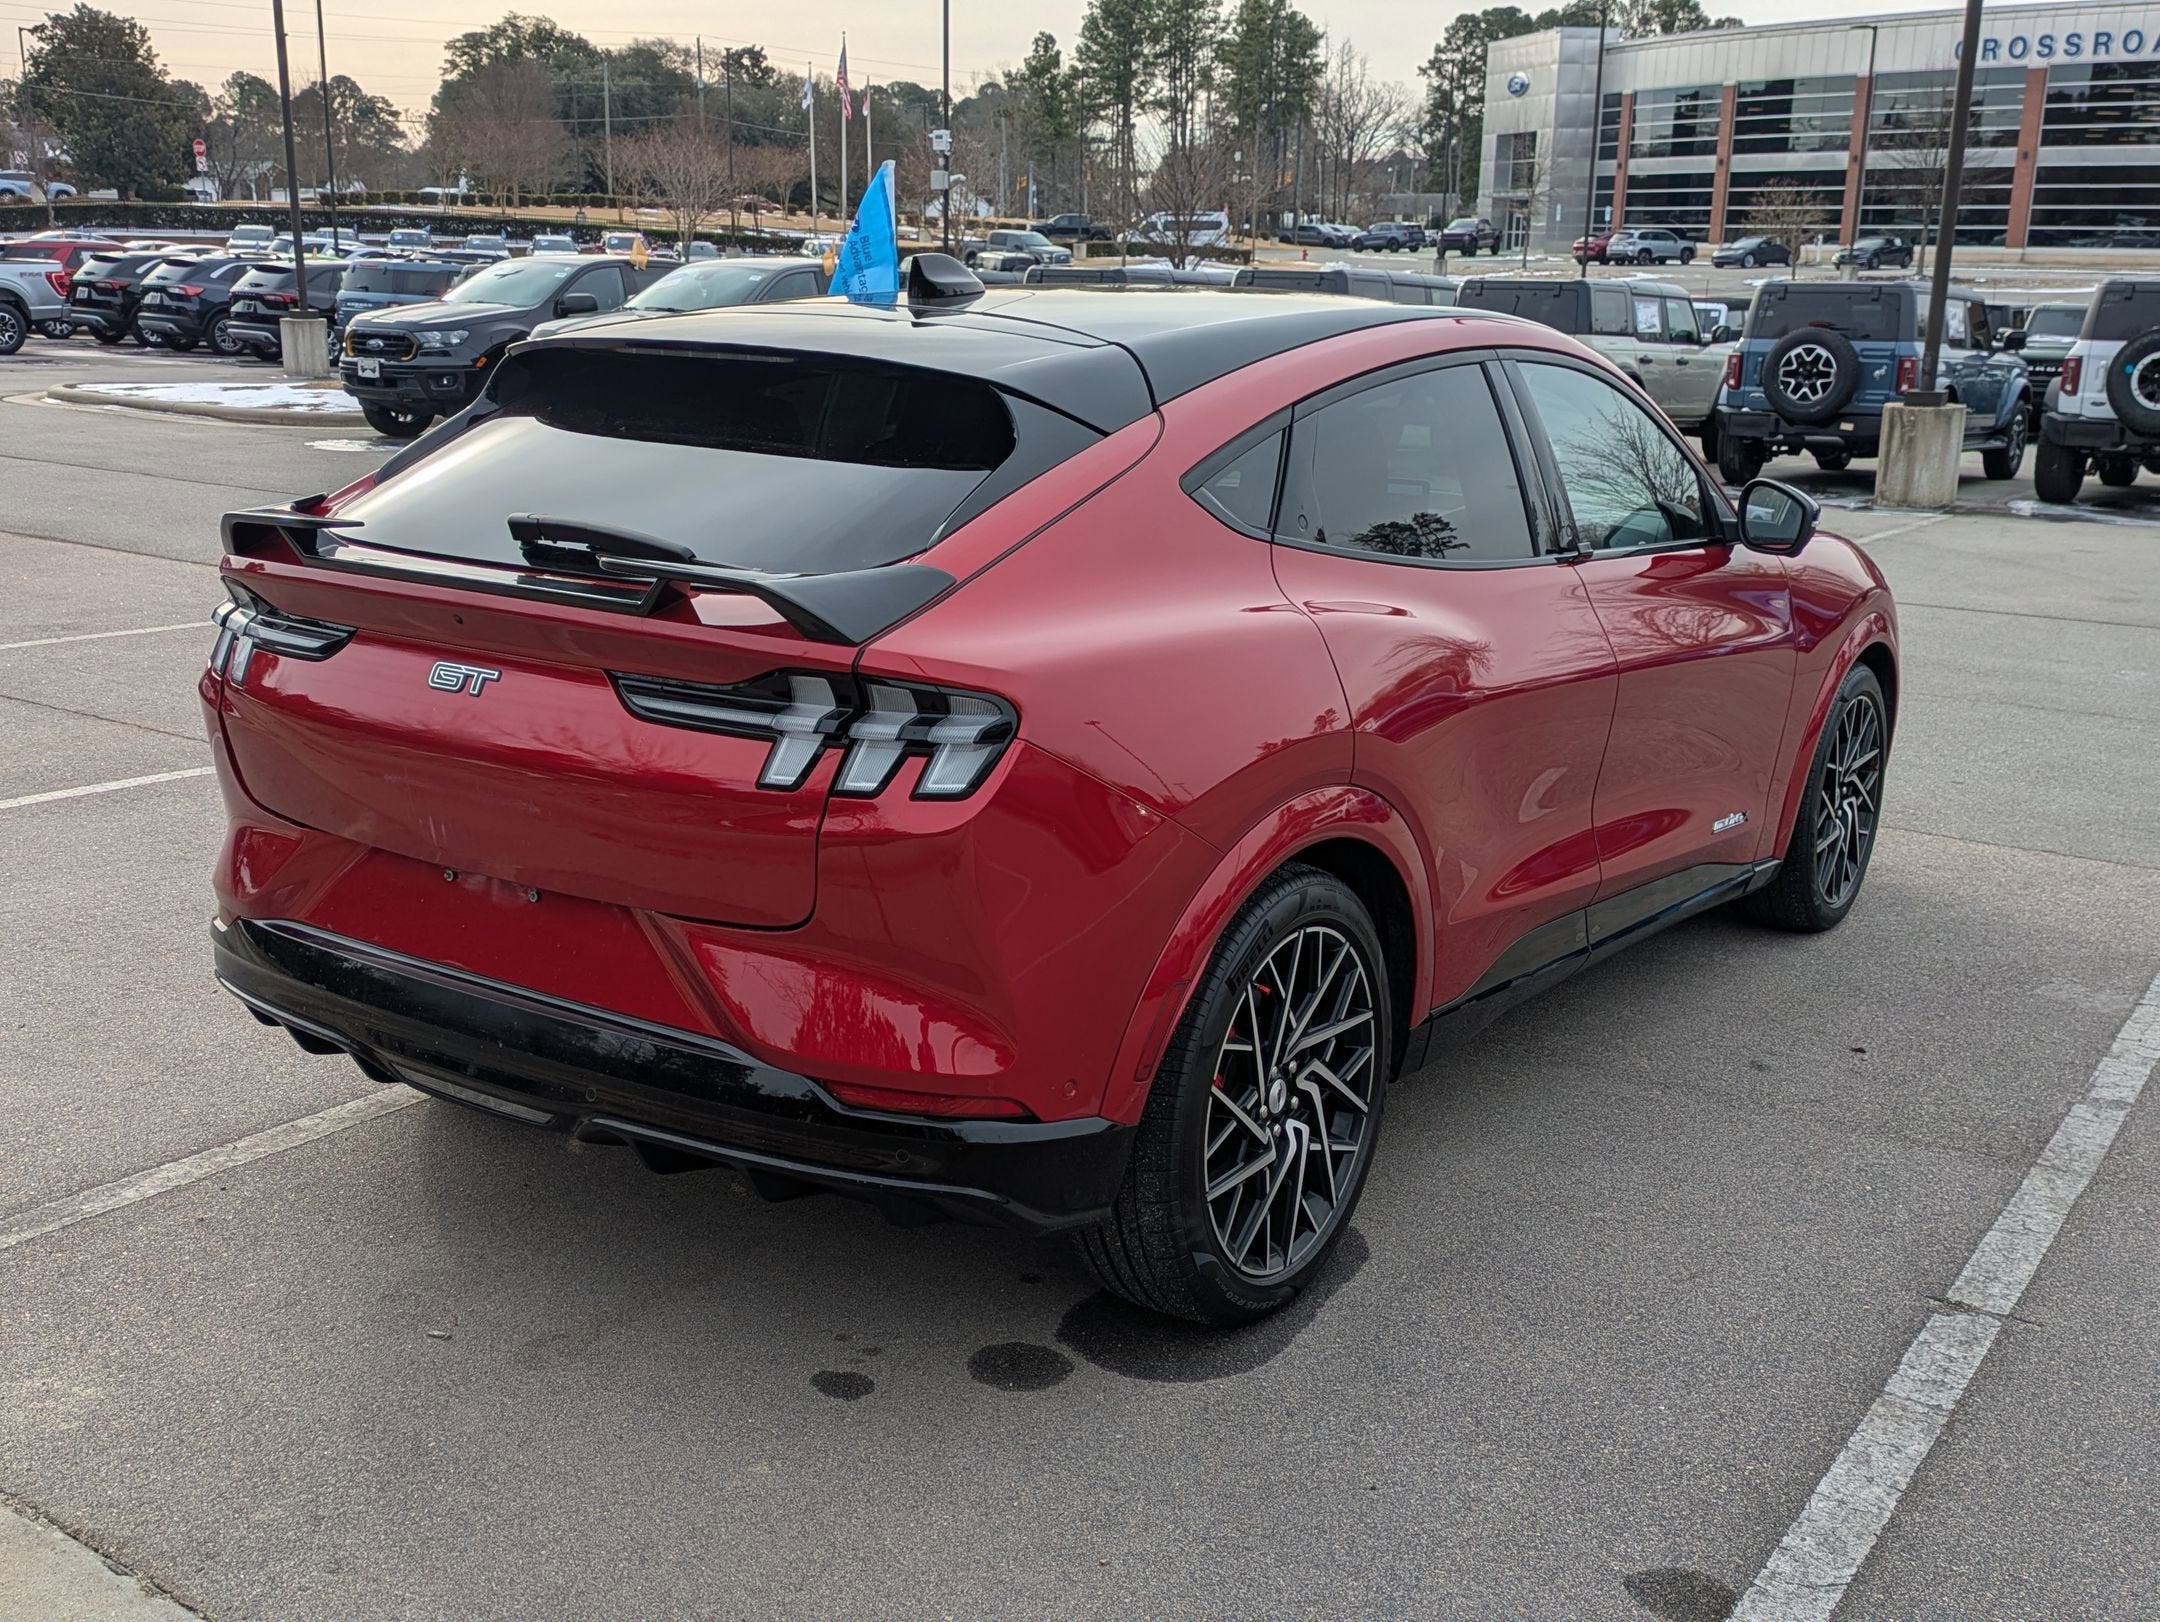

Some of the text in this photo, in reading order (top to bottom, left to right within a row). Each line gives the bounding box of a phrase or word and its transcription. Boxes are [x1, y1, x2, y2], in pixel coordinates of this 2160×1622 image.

[860, 235, 873, 262] Blue
[428, 661, 502, 697] GT
[1225, 919, 1274, 996] PIRELLI
